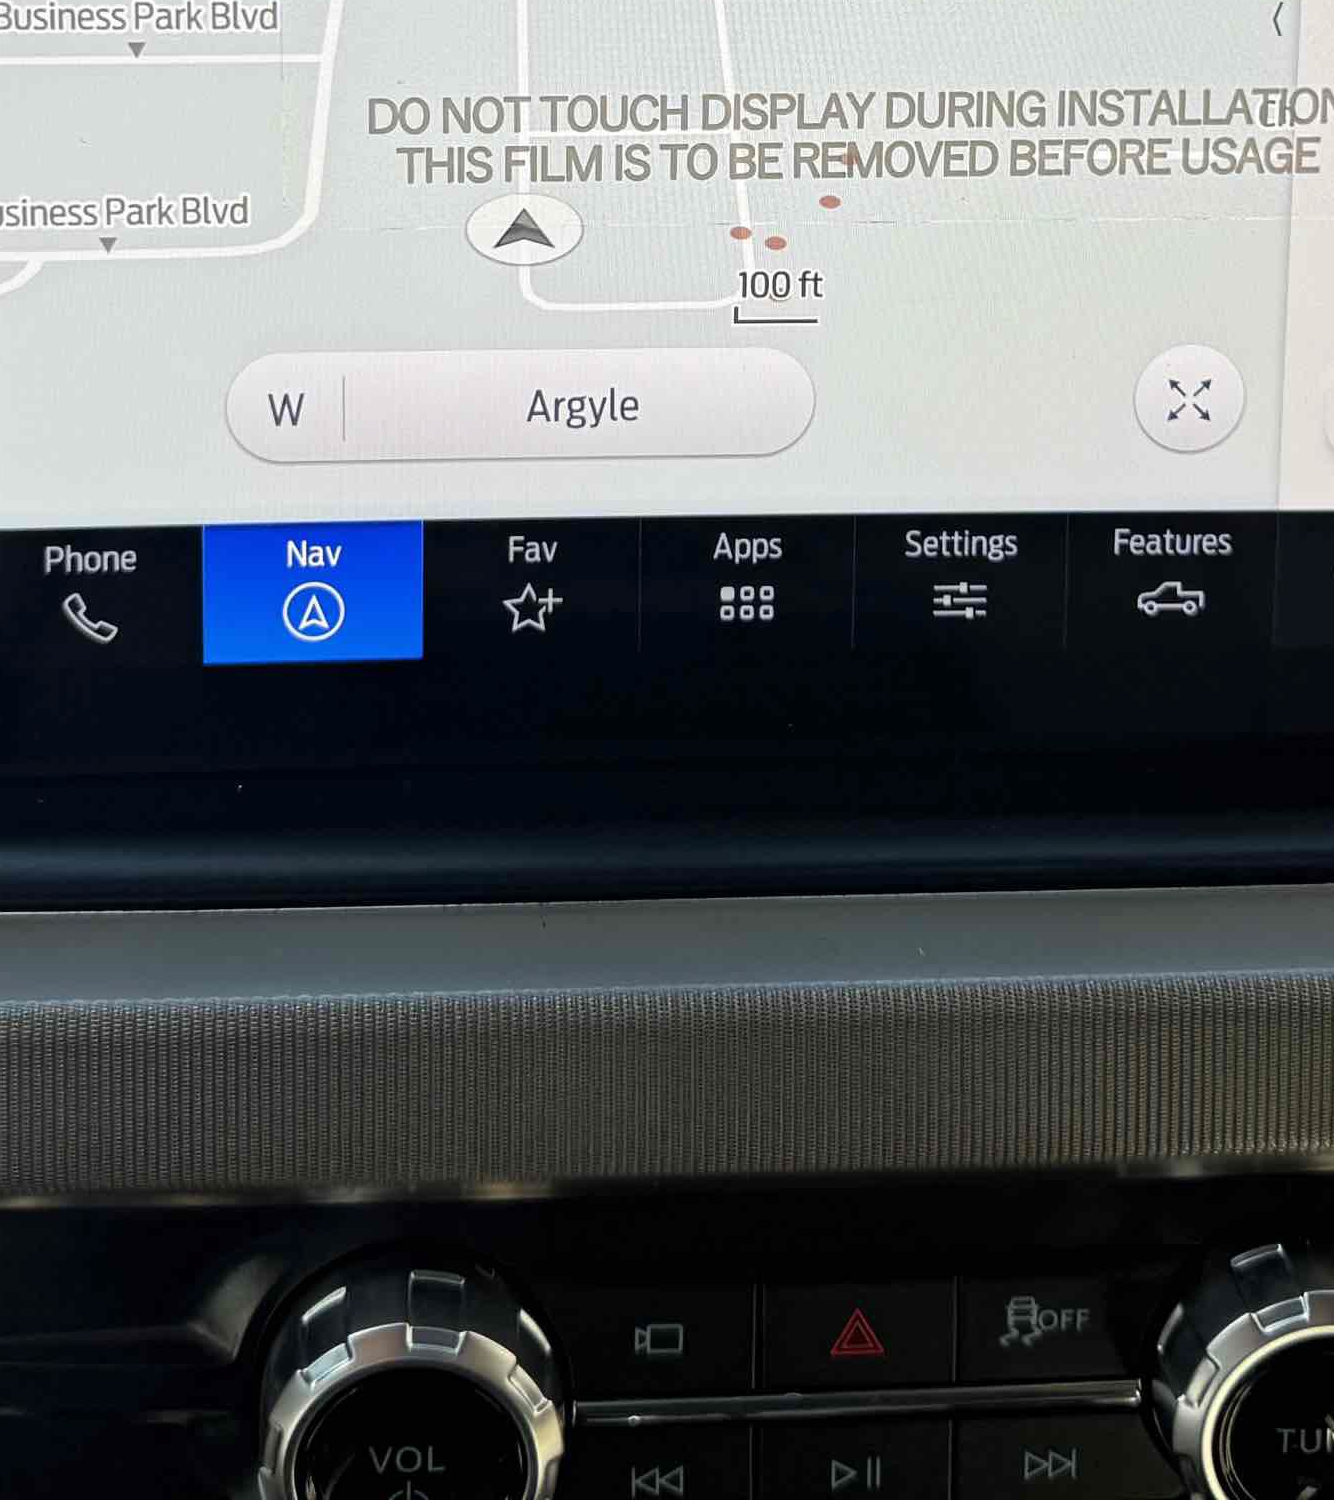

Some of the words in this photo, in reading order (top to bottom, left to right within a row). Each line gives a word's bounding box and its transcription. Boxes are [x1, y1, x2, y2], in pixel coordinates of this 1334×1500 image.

[134, 1, 202, 32] Park
[210, 1, 278, 32] Blvd
[367, 98, 431, 134] DO
[442, 97, 531, 134] NOT
[541, 96, 689, 132] TOUCH
[701, 93, 875, 130] DISPLAY
[886, 90, 1046, 127] DURING
[396, 146, 493, 183] THIS
[504, 146, 603, 183] FILM
[615, 145, 650, 181] IS
[659, 145, 718, 180] TO
[729, 143, 784, 178] BE
[791, 140, 998, 177] REMOVED
[1009, 139, 1170, 175] BEFORE
[1180, 137, 1321, 173] USAGE
[106, 196, 174, 225] Park
[182, 196, 248, 224] Blvd
[738, 270, 793, 299] 100
[798, 268, 823, 300] ft
[268, 392, 304, 427] W
[527, 387, 640, 428] Argyle
[285, 539, 341, 570] Nav
[507, 534, 558, 565] Fav
[711, 531, 783, 565] Apps
[905, 527, 1018, 563] Settings
[1112, 526, 1233, 558] Features
[43, 543, 138, 577] Phone
[1038, 1307, 1092, 1331] OFF
[369, 1446, 446, 1473] VOL
